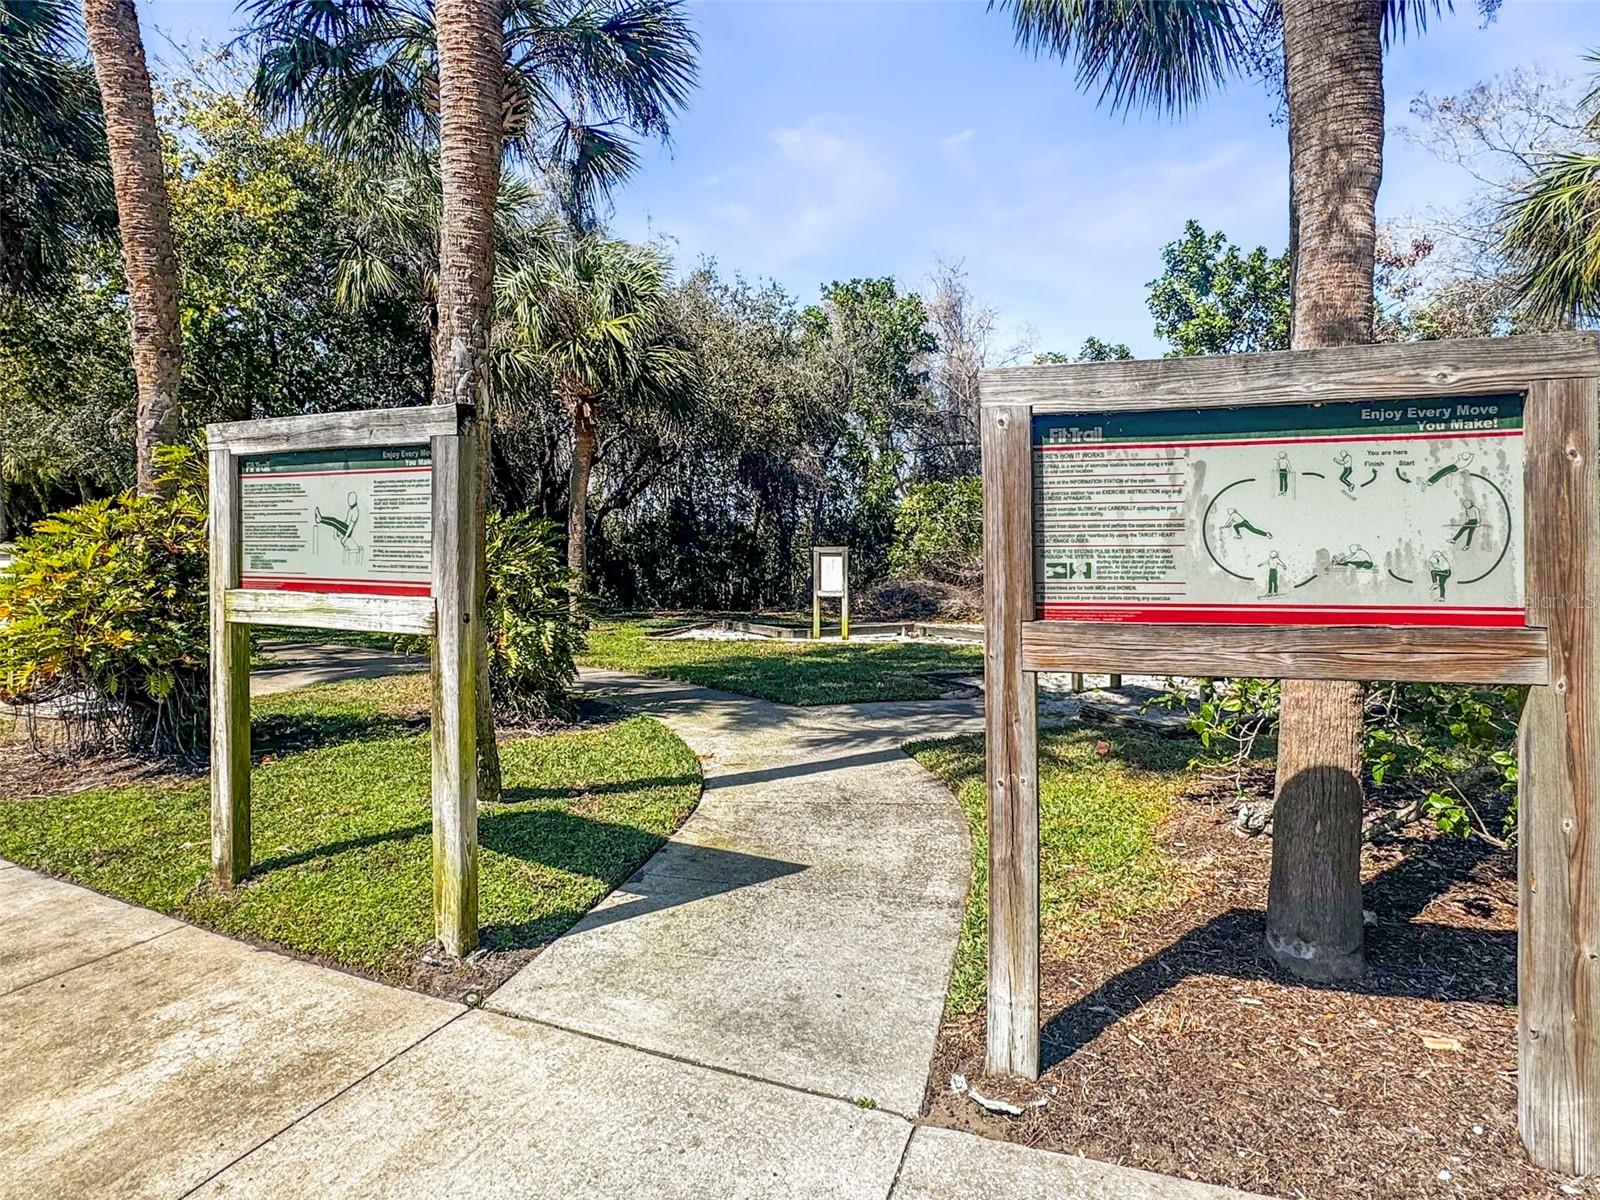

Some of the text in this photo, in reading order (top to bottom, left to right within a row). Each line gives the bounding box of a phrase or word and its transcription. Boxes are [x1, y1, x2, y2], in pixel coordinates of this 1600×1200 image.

[1361, 404, 1498, 421] Enjoy Every Move
[1417, 418, 1498, 431] You Make!
[383, 451, 400, 459] Enjoy
[401, 450, 419, 458] Every
